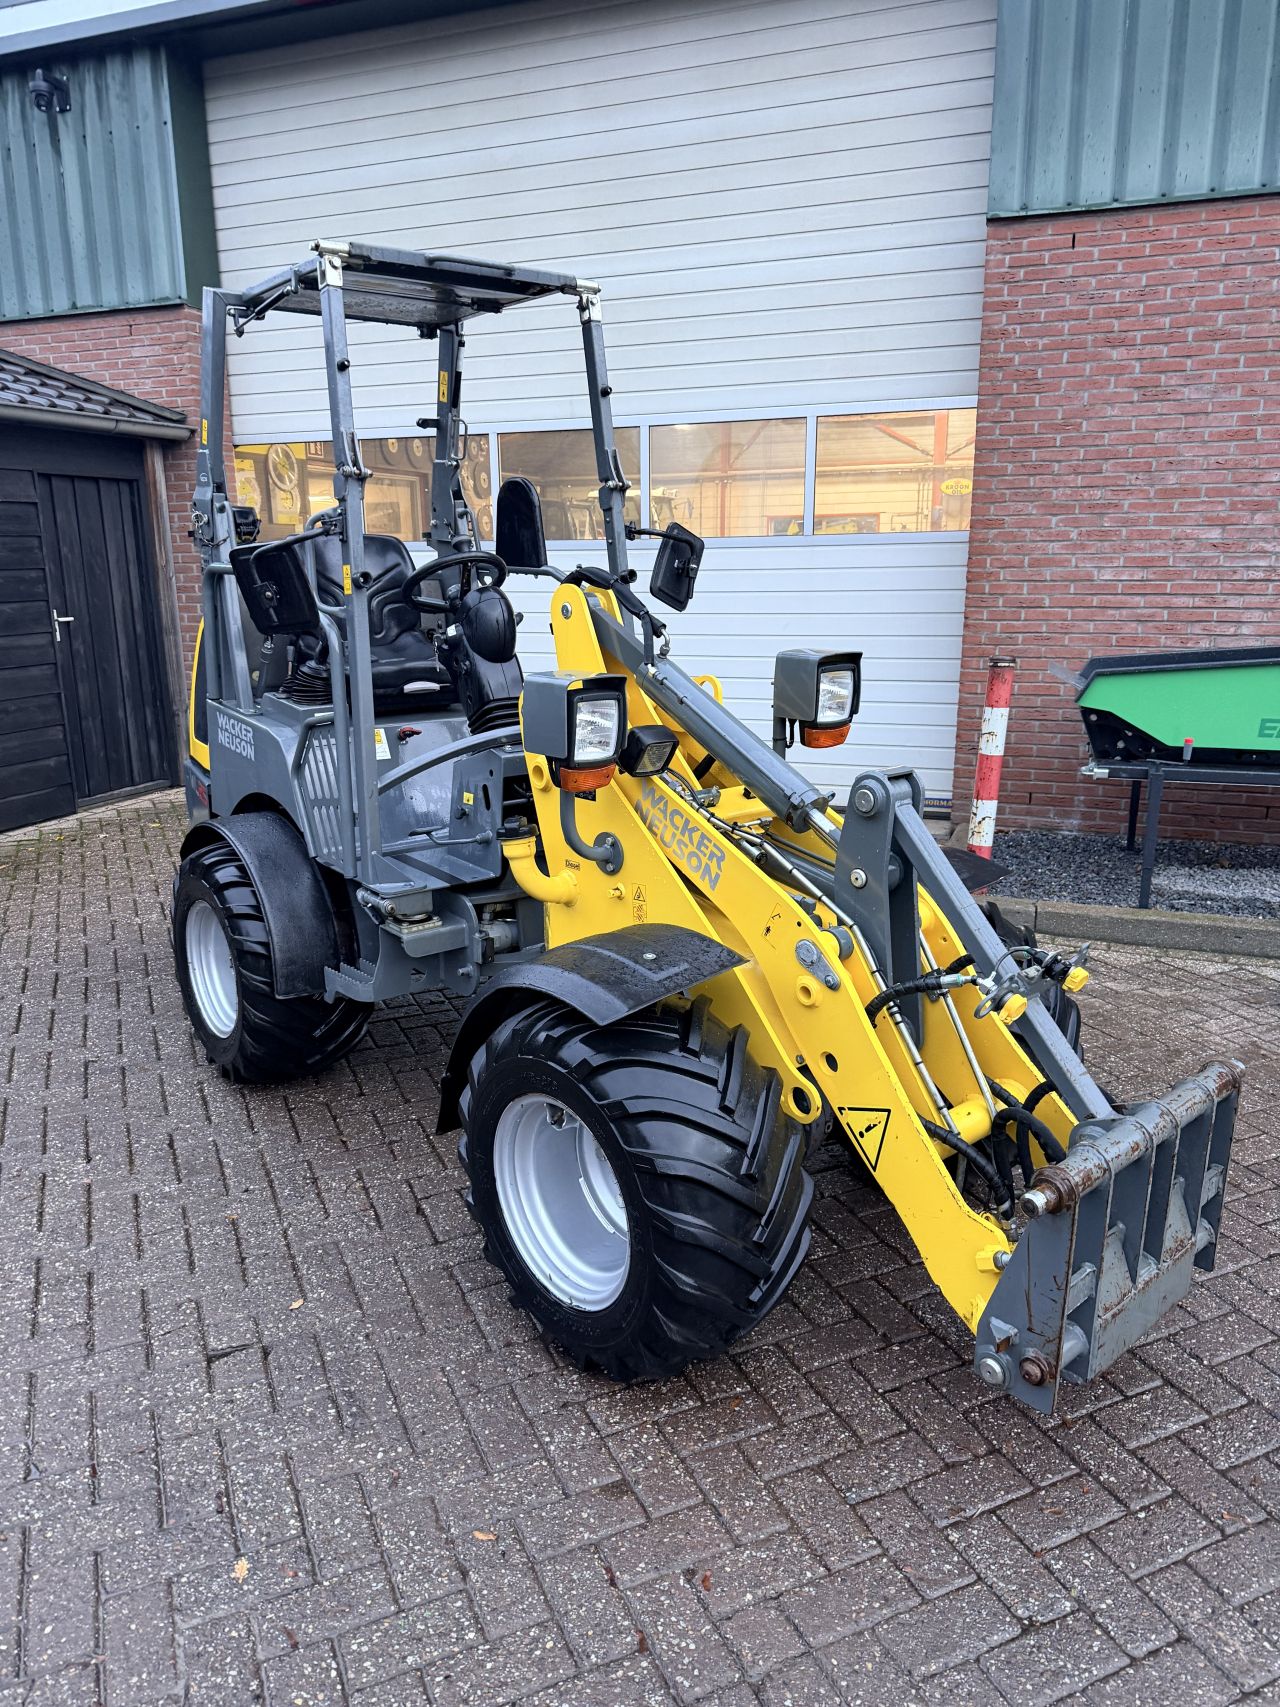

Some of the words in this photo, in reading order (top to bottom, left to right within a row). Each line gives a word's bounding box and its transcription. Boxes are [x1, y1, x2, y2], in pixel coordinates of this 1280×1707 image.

[216, 711, 254, 744] WACKER
[218, 728, 255, 761] NEUSON
[635, 799, 721, 891] NEUSON
[641, 778, 726, 872] WACKER
